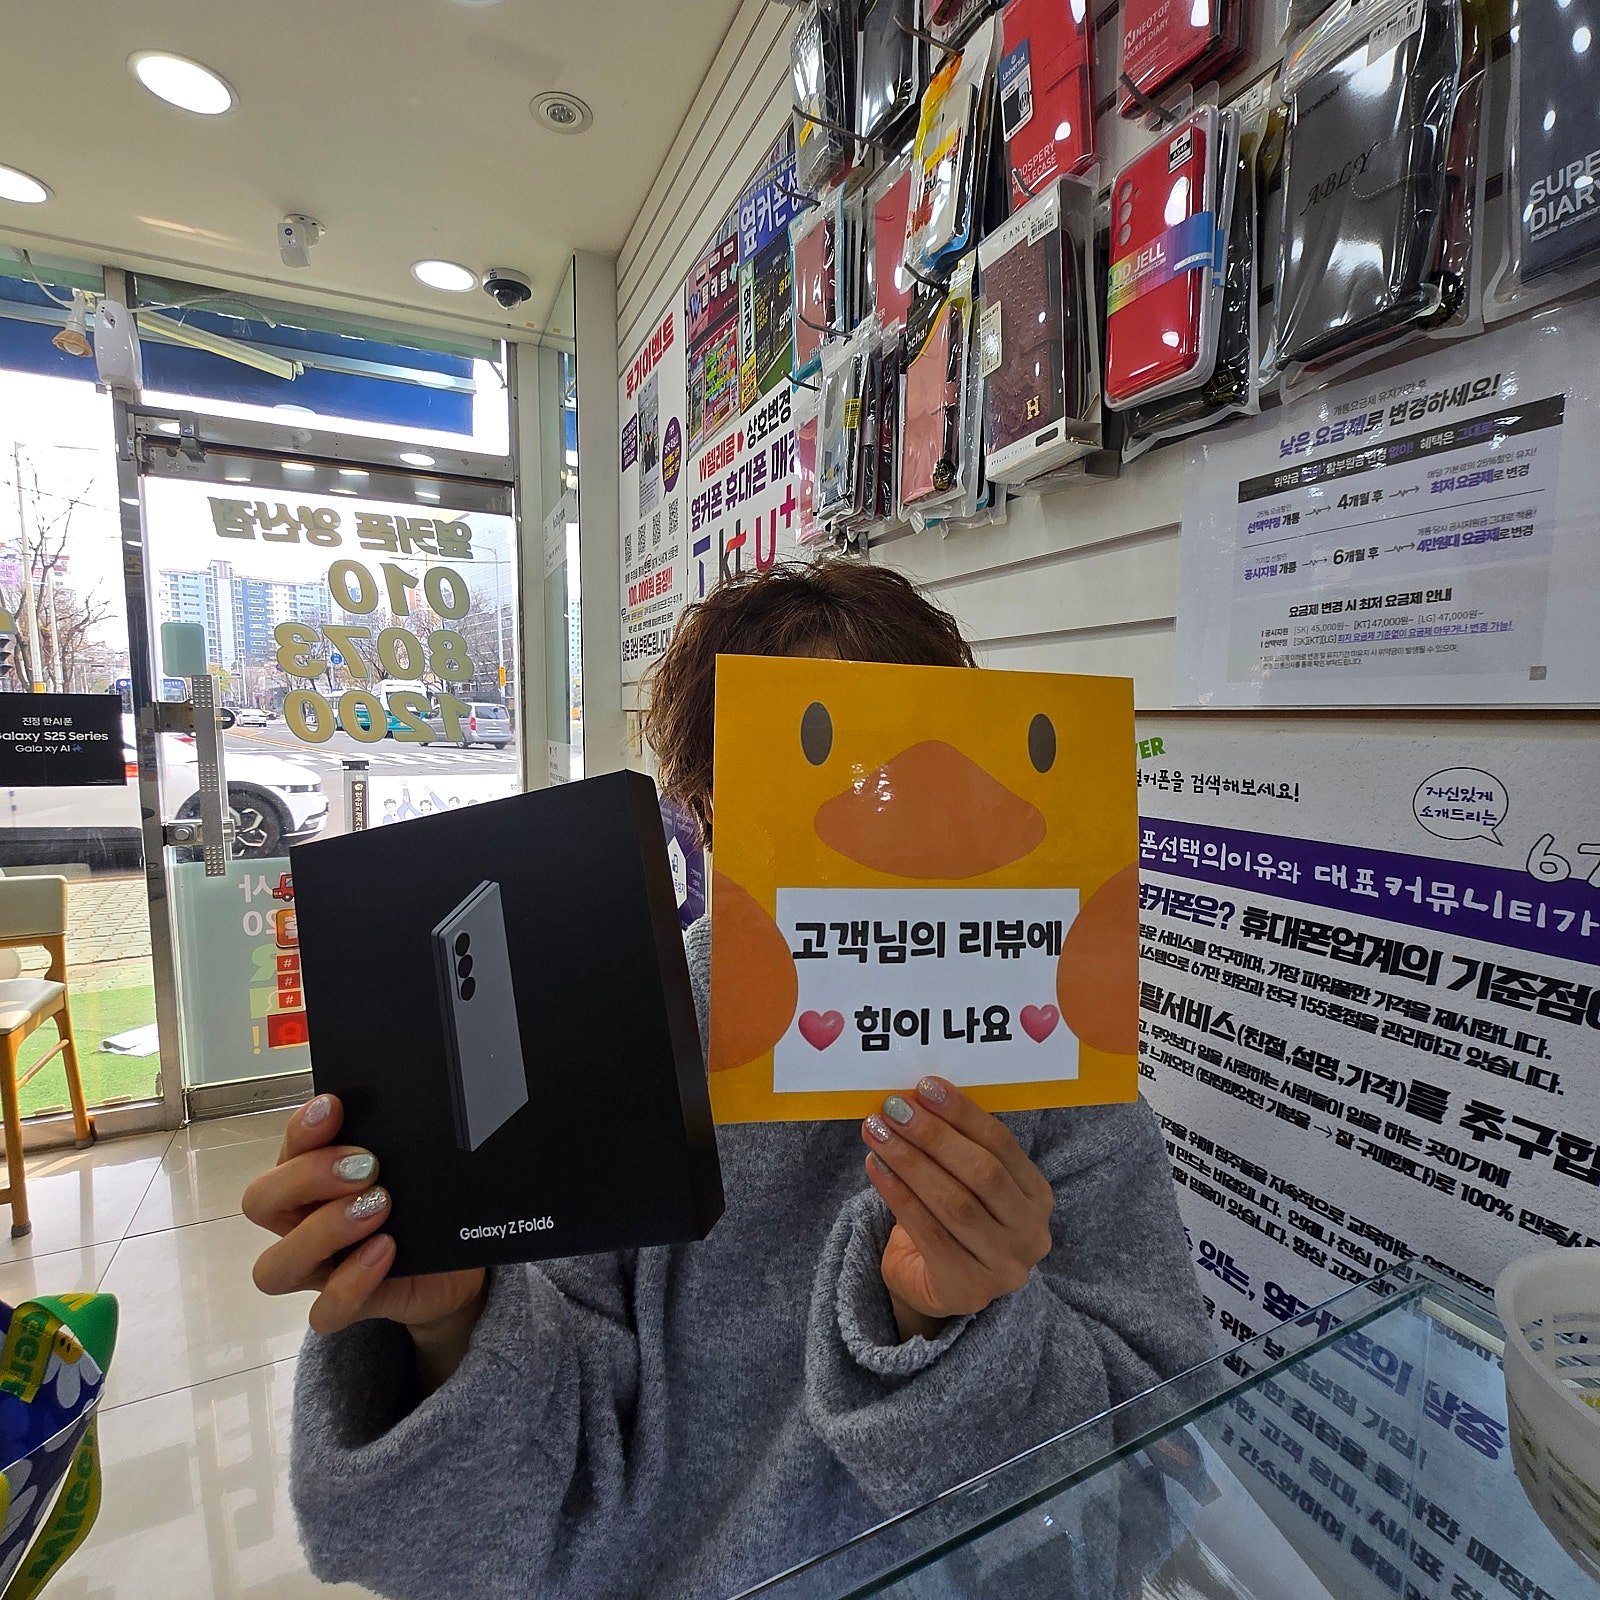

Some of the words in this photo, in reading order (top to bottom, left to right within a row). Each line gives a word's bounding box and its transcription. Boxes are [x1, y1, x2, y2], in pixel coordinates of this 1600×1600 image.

[1148, 16, 1169, 41] DIARY
[1134, 242, 1165, 273] JELL
[626, 311, 674, 400] 후기이벤트
[698, 431, 735, 483] W텔레콤
[746, 384, 791, 450] 상호변경
[1279, 429, 1315, 459] 낮은
[1313, 408, 1386, 448] 요금제로
[1389, 373, 1502, 427] 변경하세요!
[1273, 471, 1300, 489] 위약금
[1420, 430, 1456, 450] 혜택은
[691, 479, 723, 533] 옆커폰
[725, 449, 767, 512] 휴대폰
[1247, 516, 1281, 534] 선택약정
[1281, 511, 1301, 527] 개통
[1336, 491, 1370, 511] 4개월
[1371, 489, 1384, 503] 후
[1430, 478, 1455, 495] 최저
[1454, 468, 1505, 490] 요금제로
[1505, 463, 1531, 480] 변경
[1244, 564, 1278, 581] 공시지원
[1278, 560, 1298, 575] 개통
[1333, 547, 1366, 565] 6개월
[1366, 546, 1380, 561] 후
[1416, 533, 1461, 552] 4만원대
[1289, 603, 1319, 618] 요금제
[1321, 600, 1344, 615] 변경
[1344, 598, 1357, 611] 시
[1359, 595, 1383, 611] 최저
[1384, 591, 1423, 608] 요금제
[1425, 587, 1453, 602] 안내
[1353, 619, 1371, 630] [KT]
[1418, 613, 1436, 625] [LG]
[1353, 631, 1376, 641] 요금제
[1408, 627, 1432, 638] 요금제
[1433, 624, 1469, 635] 아무거나
[1470, 621, 1489, 634] 변경
[1490, 620, 1513, 632] 가능!
[43, 731, 67, 741] S25
[68, 731, 109, 741] Series
[60, 744, 71, 753] AI
[1190, 773, 1300, 803] 검색해보세요!
[1419, 805, 1498, 827] 소개드리는
[1425, 786, 1494, 803] 자신있게
[792, 920, 946, 964] 고객님의
[958, 919, 1063, 960] 리뷰에
[1240, 905, 1444, 986] 휴대폰업계의
[1158, 929, 1207, 957] 서비스를
[1207, 942, 1266, 975] 연구하며,
[1267, 960, 1301, 984] 가장
[1300, 970, 1372, 1005] 파워풀한
[1372, 990, 1432, 1024] 가격을
[1431, 1007, 1553, 1061] 제시합니다.
[854, 1005, 930, 1052] 힘이
[943, 1005, 1013, 1044] 나요
[1191, 961, 1221, 983] 67만
[1220, 967, 1266, 998] 회원과
[1266, 983, 1299, 1009] 전국
[1380, 1019, 1464, 1062] 관리하고
[1464, 1046, 1565, 1096] 있습니다.
[1150, 1025, 1197, 1056] 무엇보다
[1197, 1044, 1224, 1067] 일을
[1223, 1056, 1280, 1092] 사랑하는
[1280, 1080, 1345, 1119] 사람들이
[1345, 1105, 1383, 1135] 일을
[1383, 1120, 1423, 1152] 하는
[1423, 1138, 1512, 1189] 곳이기에
[1265, 1097, 1312, 1131] 기분을
[1335, 1128, 1356, 1151] 잘
[1461, 1182, 1515, 1222] 100%
[1176, 1146, 1212, 1178] 만드는
[1212, 1167, 1282, 1219] 비결입니다.
[1287, 1209, 1336, 1247] 언제나
[1336, 1235, 1373, 1270] 진심
[1188, 1130, 1215, 1156] 위해
[1215, 1144, 1269, 1186] 점주들을
[1269, 1174, 1346, 1227] 지속적으로
[1346, 1215, 1420, 1261] 교육하는
[1189, 1175, 1227, 1210] 믿음이
[1226, 1198, 1290, 1248] 있습니다.
[1291, 1236, 1329, 1270] 항상
[460, 1225, 506, 1240] Galaxy
[508, 1221, 517, 1234] Z
[518, 1216, 555, 1233] Fold6
[1196, 1239, 1256, 1302] 있는,
[1259, 1416, 1305, 1465] 고객
[1290, 1398, 1368, 1472] 검증을
[1361, 1405, 1428, 1471] 가입!
